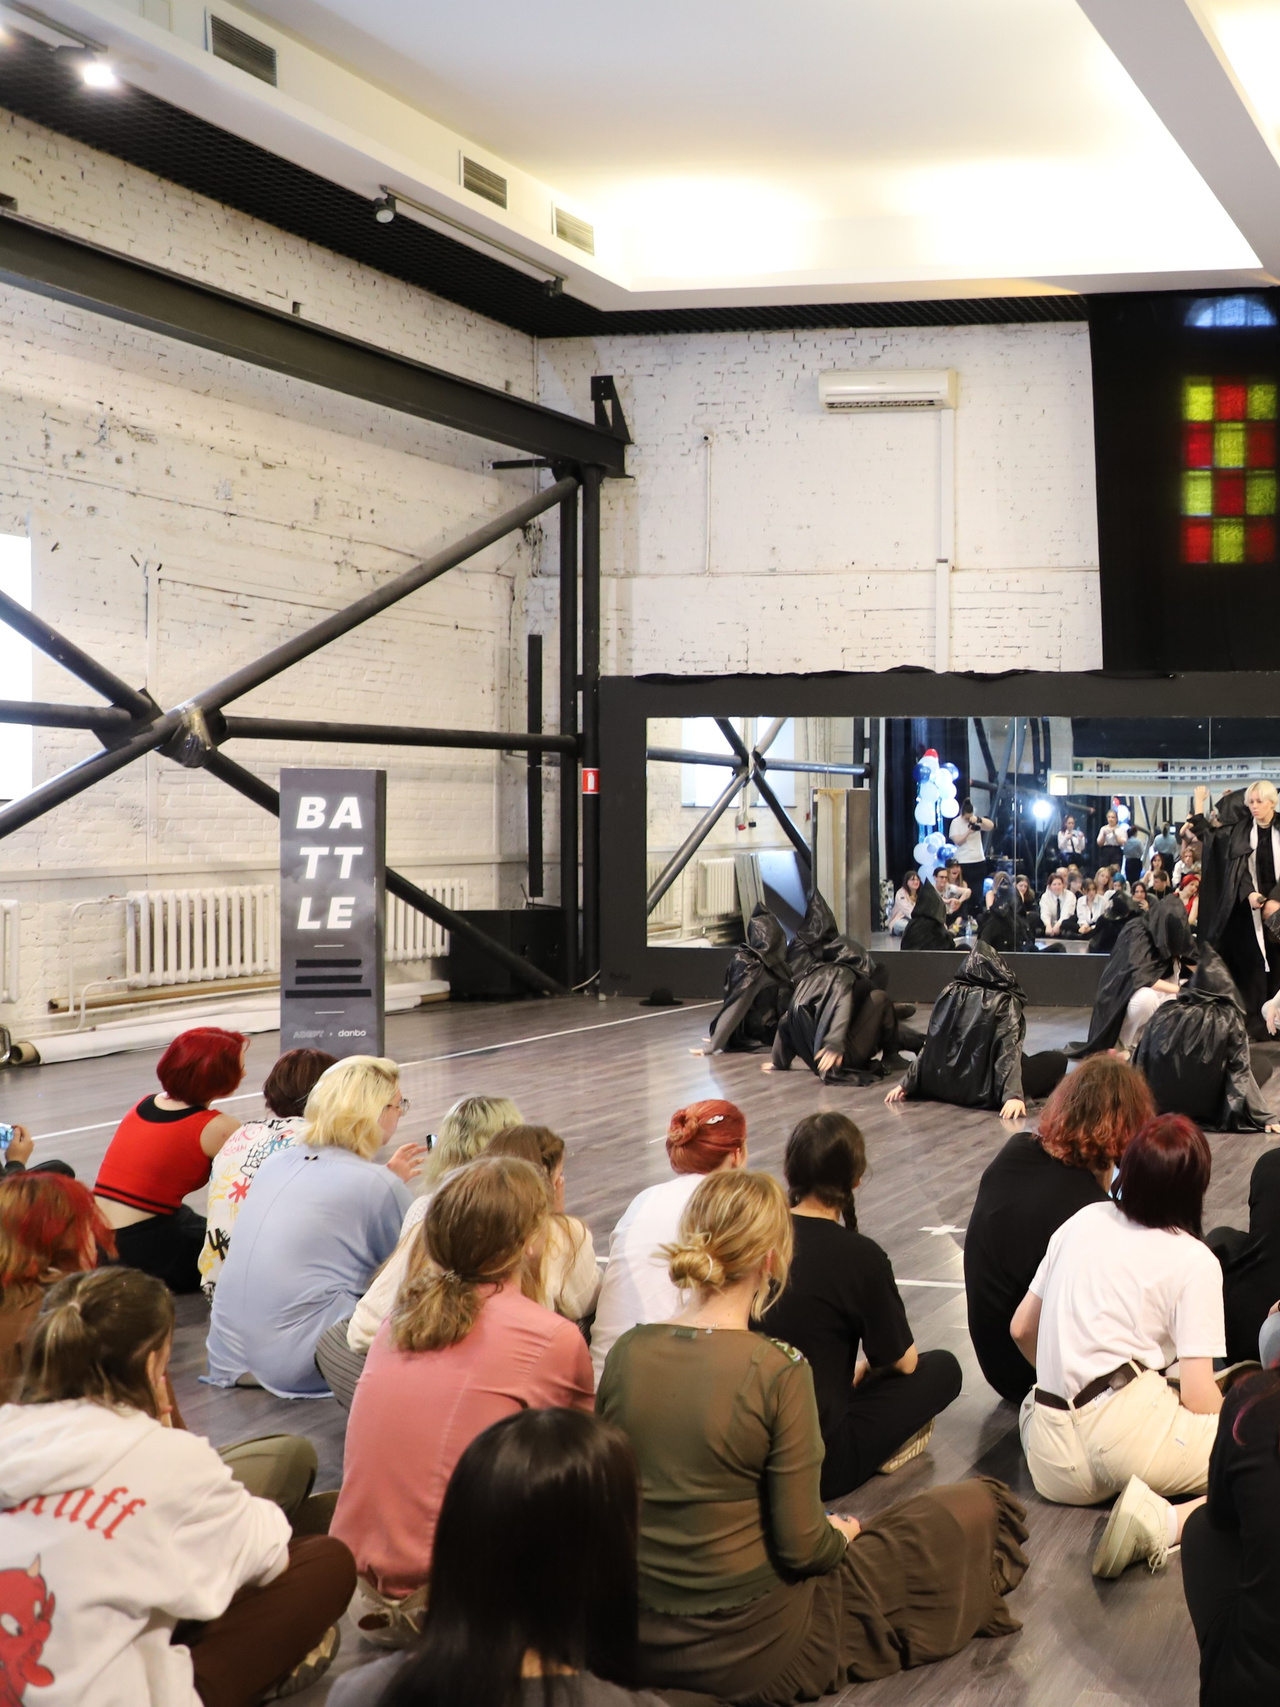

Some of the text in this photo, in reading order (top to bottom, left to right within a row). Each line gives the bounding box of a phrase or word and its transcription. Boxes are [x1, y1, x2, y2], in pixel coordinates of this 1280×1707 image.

[296, 796, 363, 830] BA
[299, 847, 363, 880] TT
[297, 897, 355, 930] LE
[338, 1029, 366, 1038] danbo
